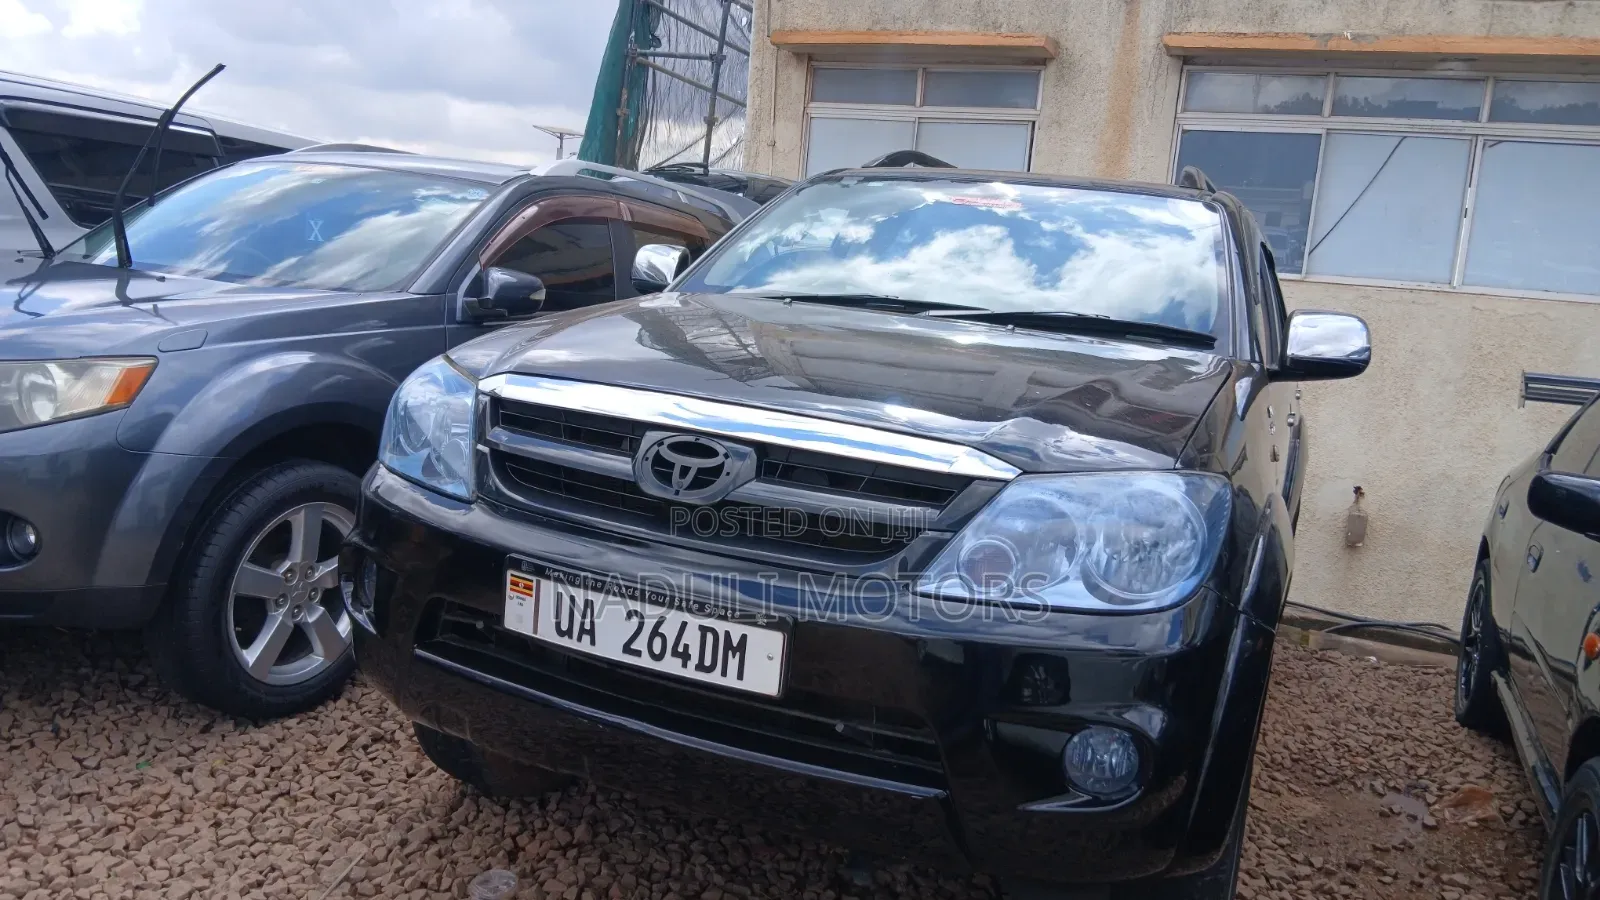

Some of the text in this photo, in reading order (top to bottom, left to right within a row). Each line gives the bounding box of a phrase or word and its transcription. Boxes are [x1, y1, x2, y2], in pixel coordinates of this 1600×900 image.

[545, 567, 740, 619] Making the Roads Your Safe Space
[555, 591, 748, 681] UA 264DM
